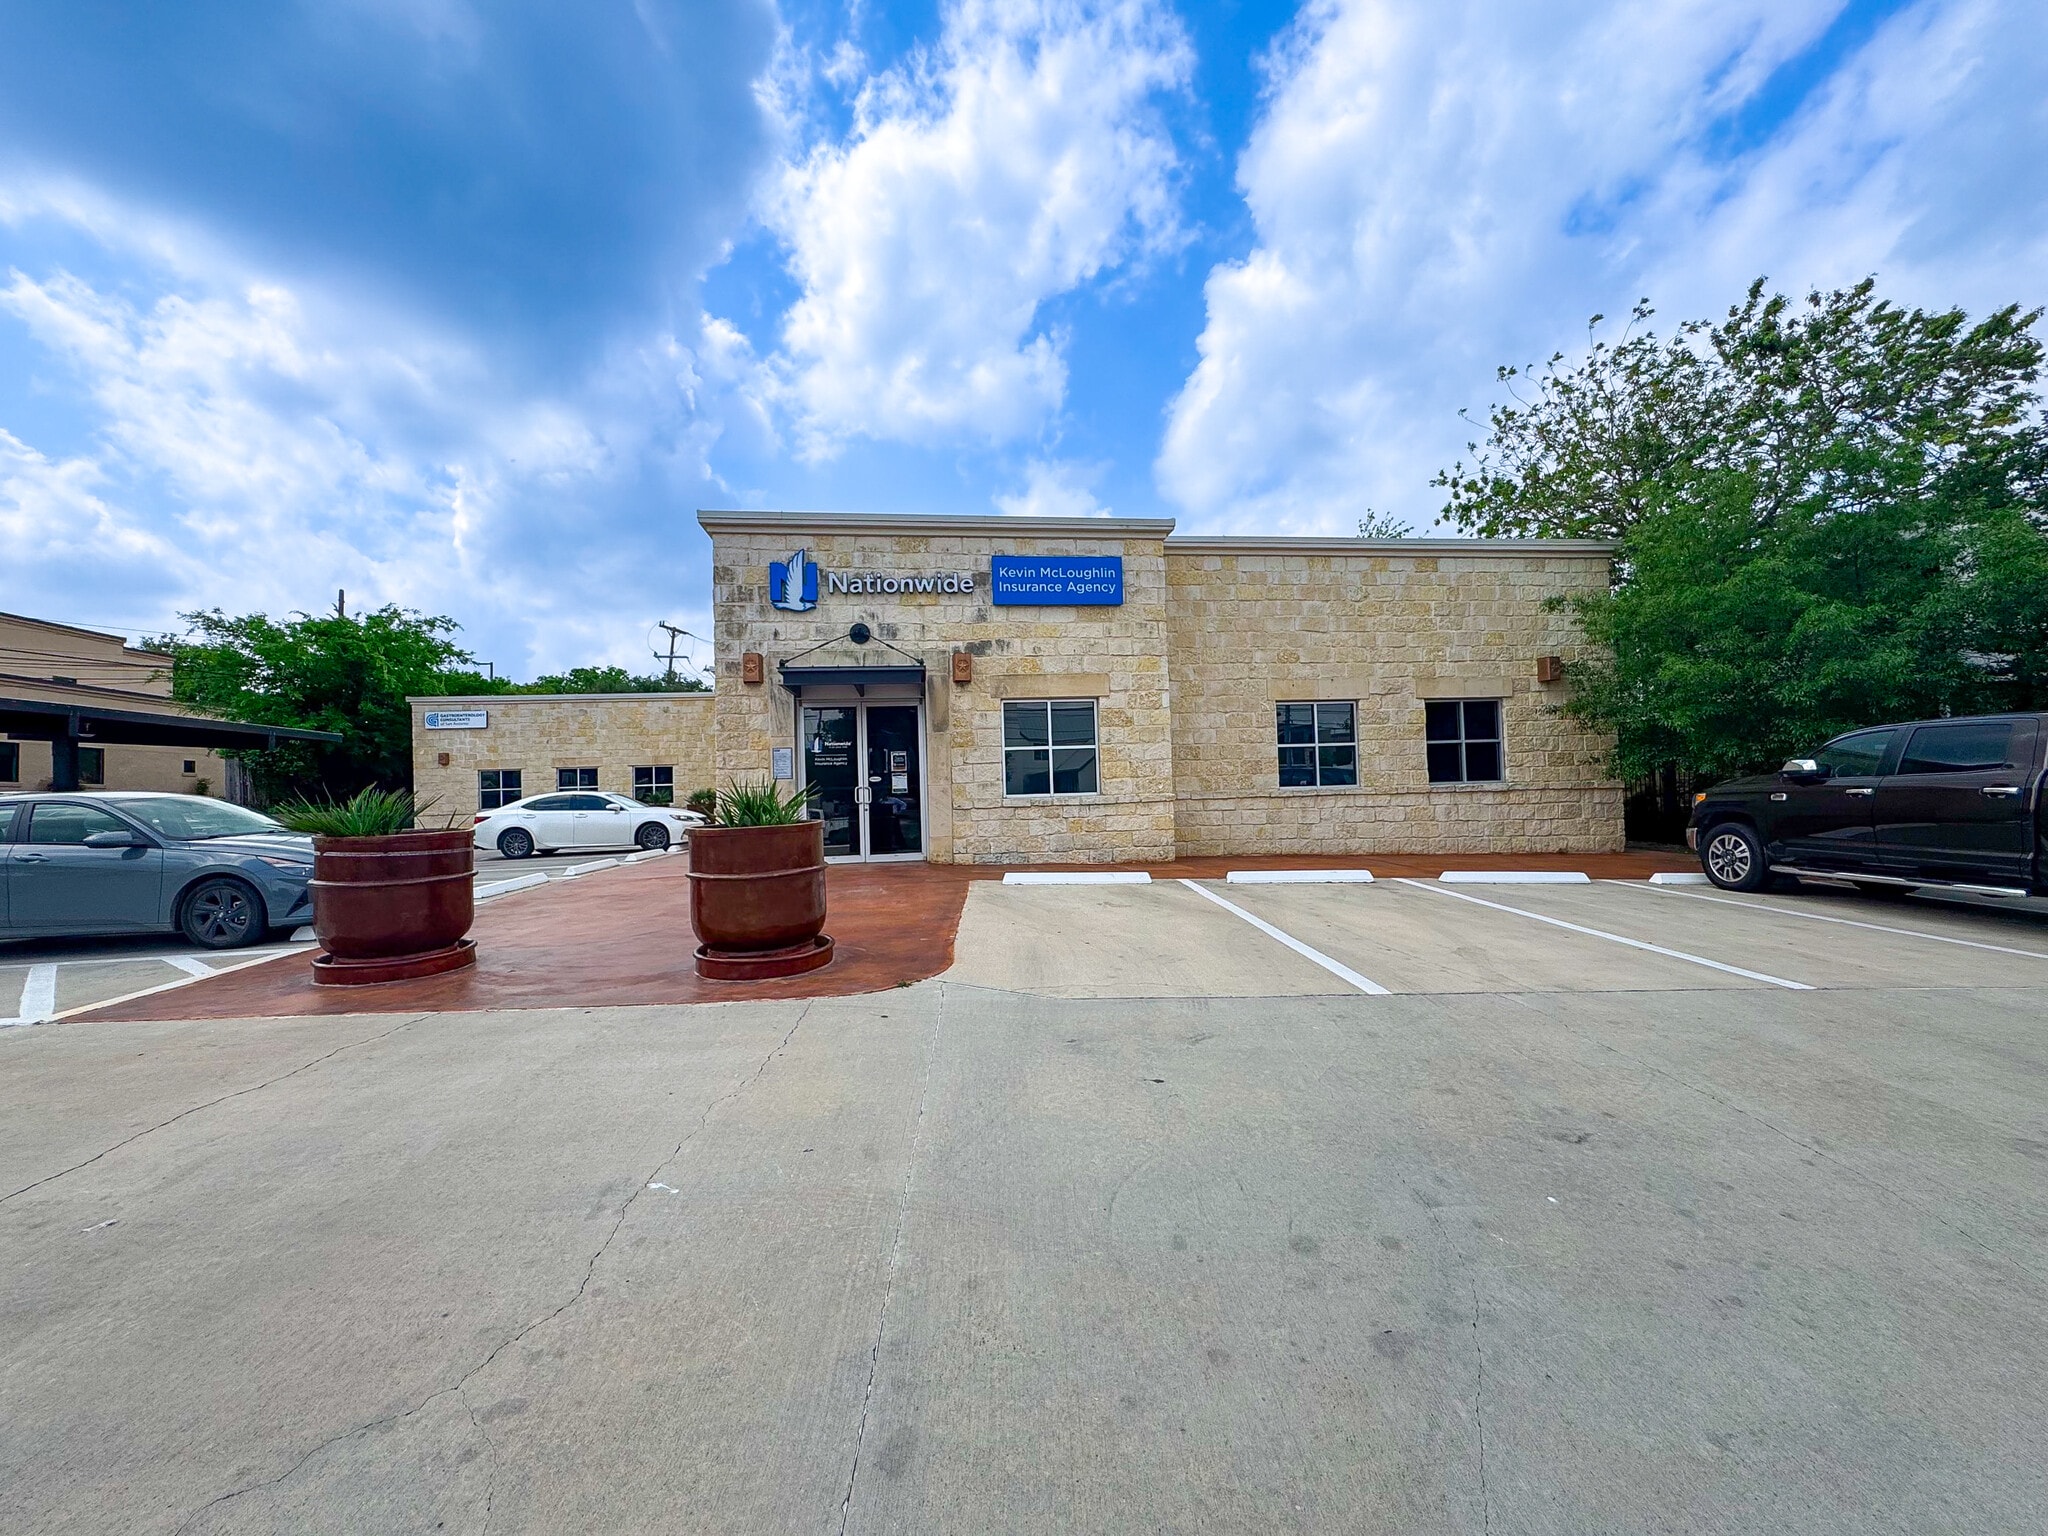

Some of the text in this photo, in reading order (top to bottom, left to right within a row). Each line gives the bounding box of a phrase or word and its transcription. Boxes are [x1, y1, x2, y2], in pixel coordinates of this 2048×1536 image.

[998, 566, 1116, 580] Kevin McLoughlin
[828, 572, 975, 596] Nationwide
[998, 581, 1116, 595] Insurance Agency
